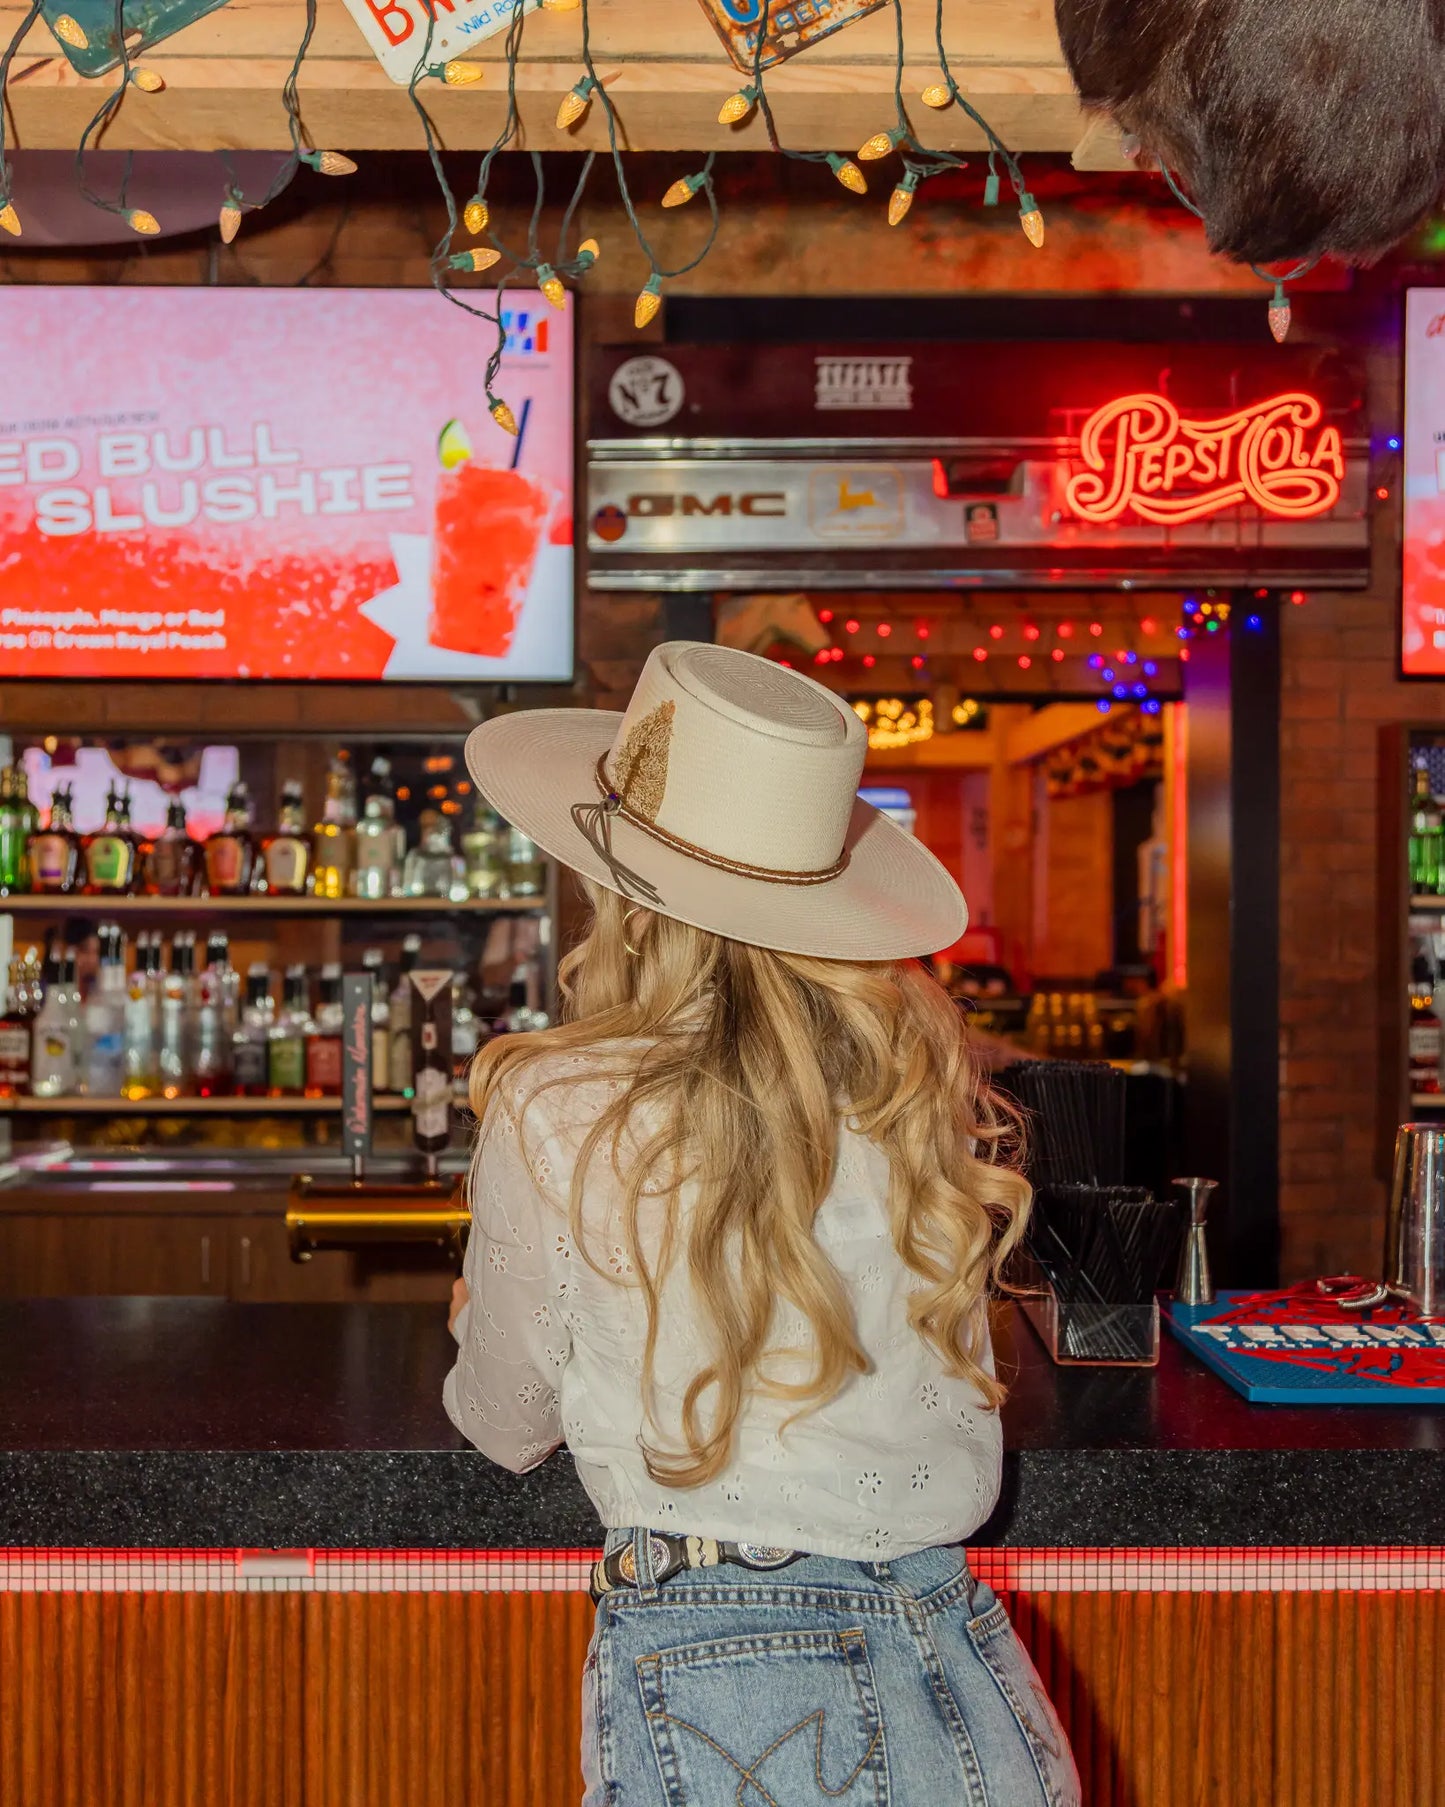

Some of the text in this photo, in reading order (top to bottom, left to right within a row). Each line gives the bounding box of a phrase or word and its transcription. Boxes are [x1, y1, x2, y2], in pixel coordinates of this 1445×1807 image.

[456, 10, 492, 35] Wild
[99, 422, 301, 477] BULL
[35, 463, 416, 536] SLUSHIE
[627, 492, 786, 517] GMC
